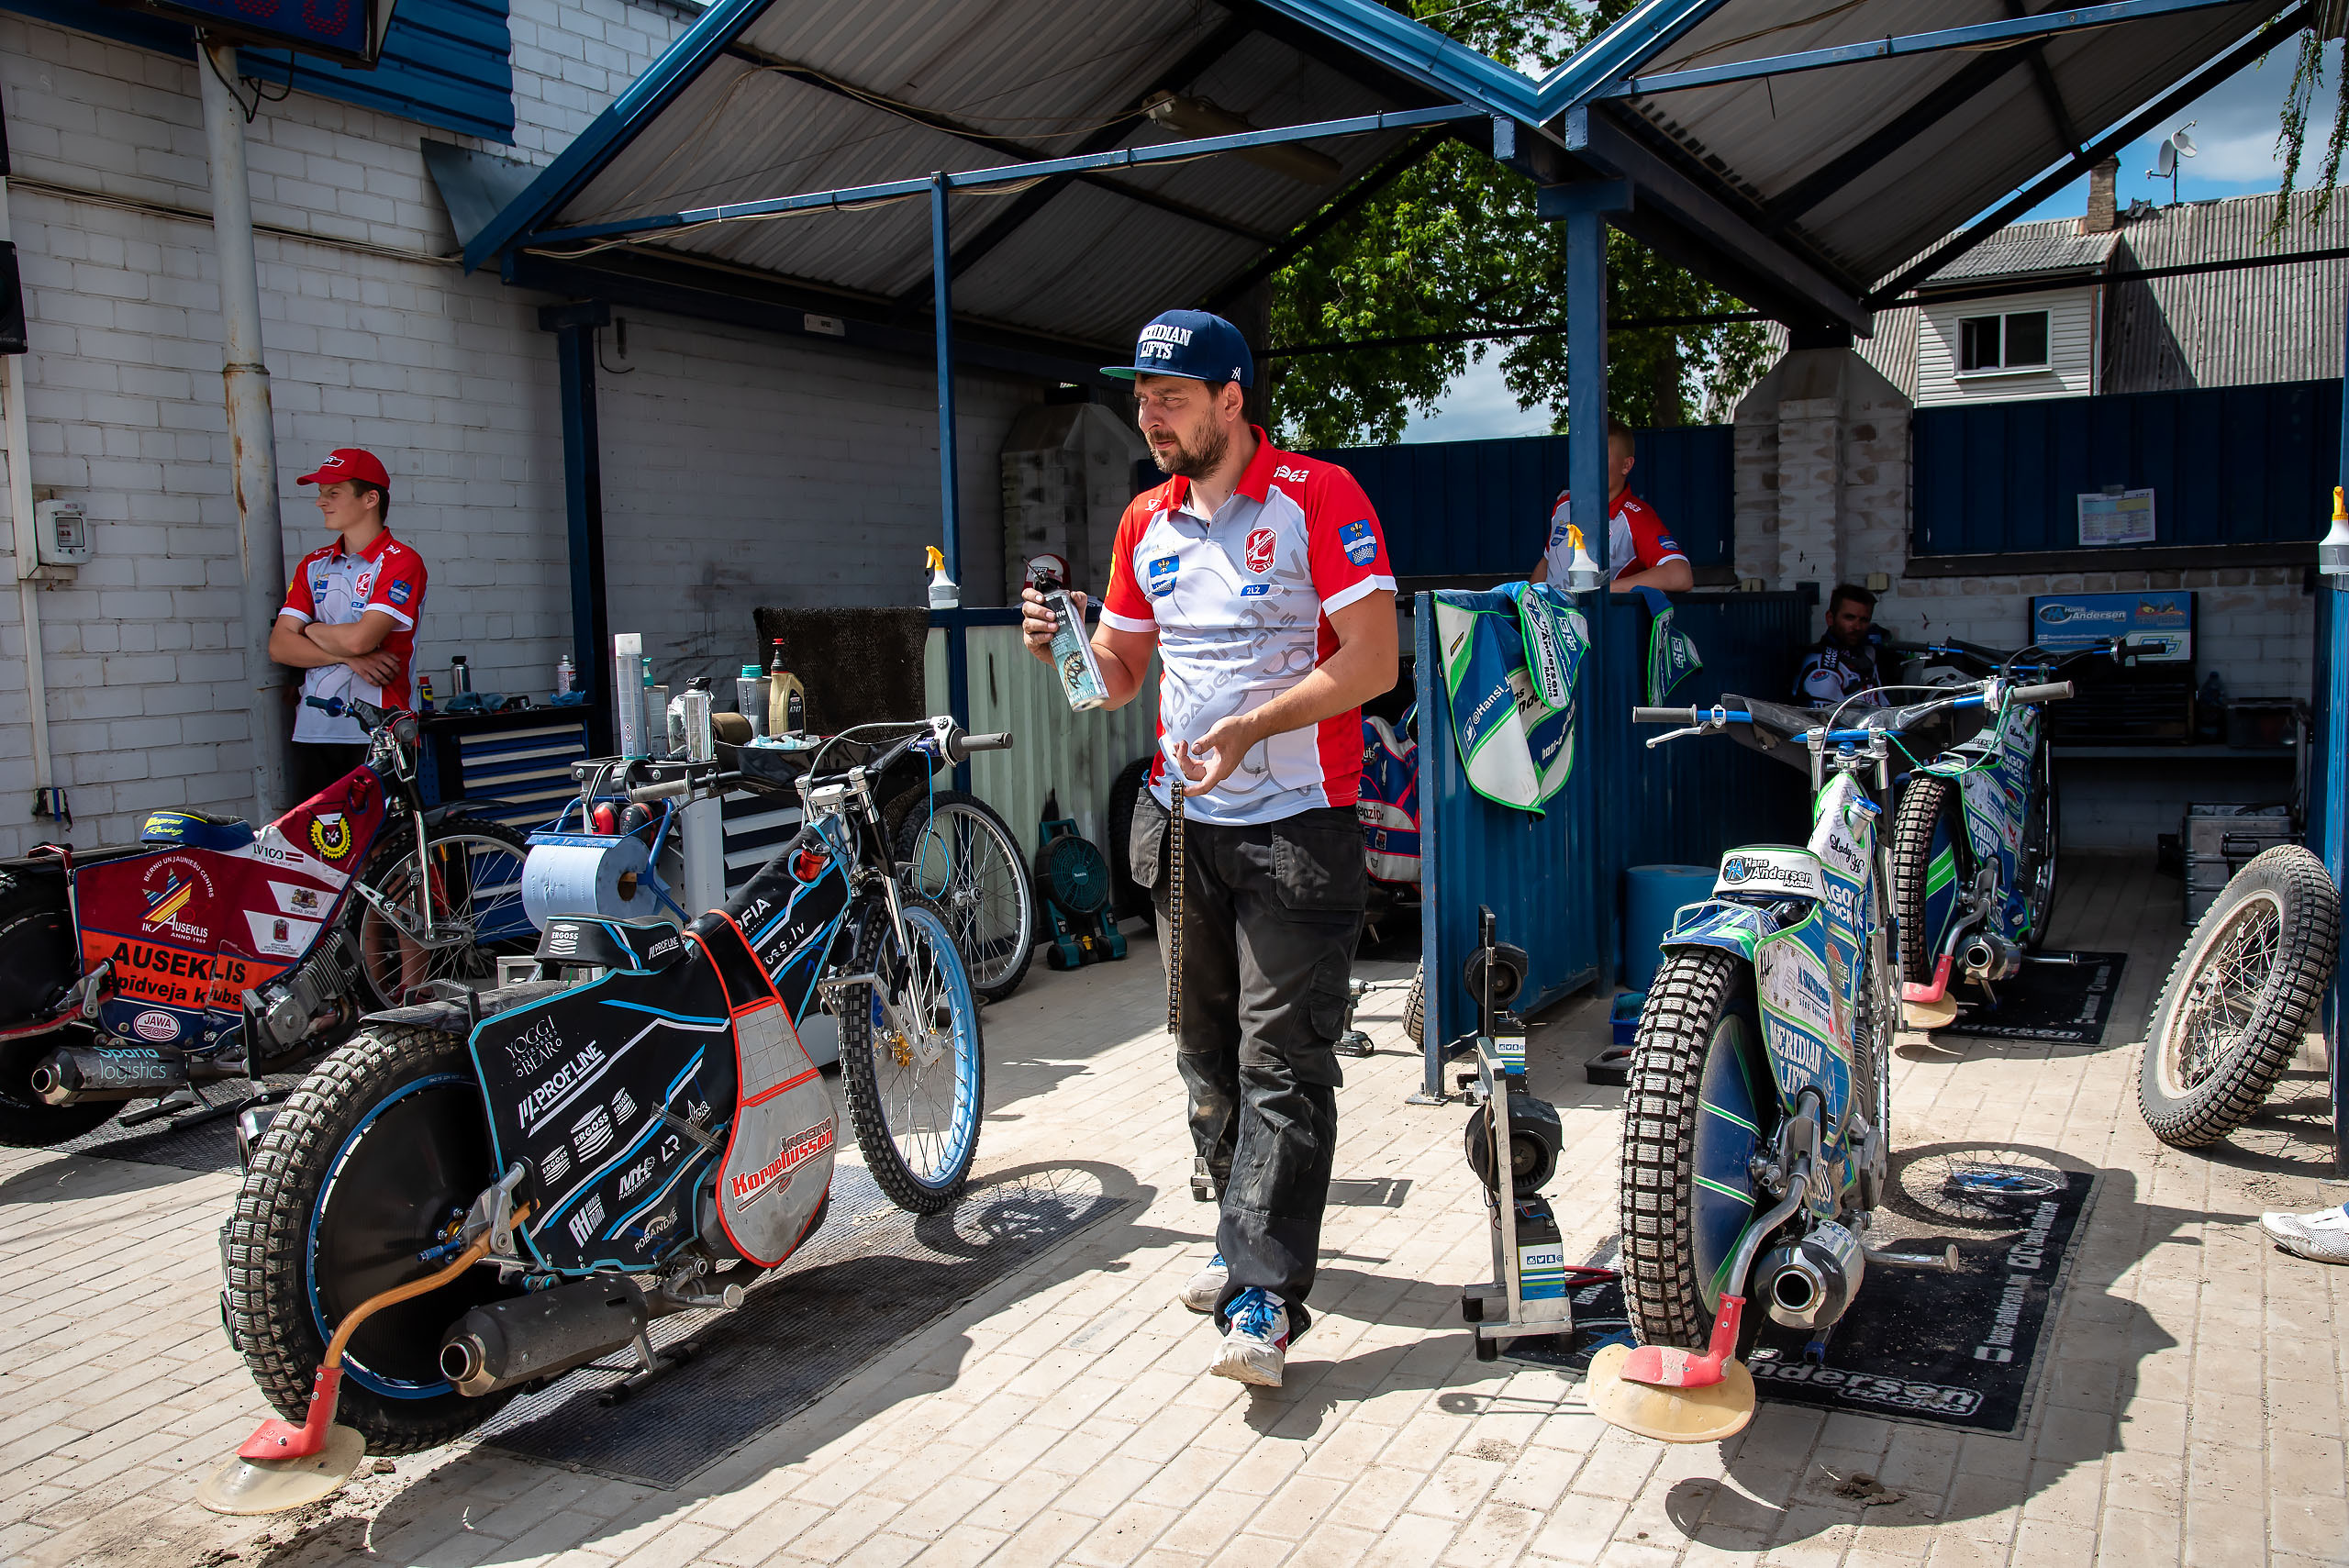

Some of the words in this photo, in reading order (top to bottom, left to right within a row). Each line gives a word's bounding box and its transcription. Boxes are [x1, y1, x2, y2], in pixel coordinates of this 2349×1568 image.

[1140, 341, 1174, 361] LIFTS
[1273, 465, 1309, 483] 1963
[1744, 857, 1769, 868] Hans
[1752, 866, 1813, 884] Andersen
[1783, 880, 1814, 889] RACING
[551, 931, 579, 940] ERGOSS
[111, 942, 247, 984] AUSEKLIS
[144, 1015, 172, 1029] JAWA
[505, 1015, 555, 1059] YOGGI
[1769, 1019, 1822, 1075] MERIDIAN
[521, 1041, 560, 1076] BEAR
[99, 1059, 167, 1084] logistics
[613, 1092, 630, 1114] ERGOSS
[573, 1112, 610, 1147] ERGOSS
[542, 1150, 569, 1175] ERGOSS
[1746, 1360, 1976, 1409] ndersen
